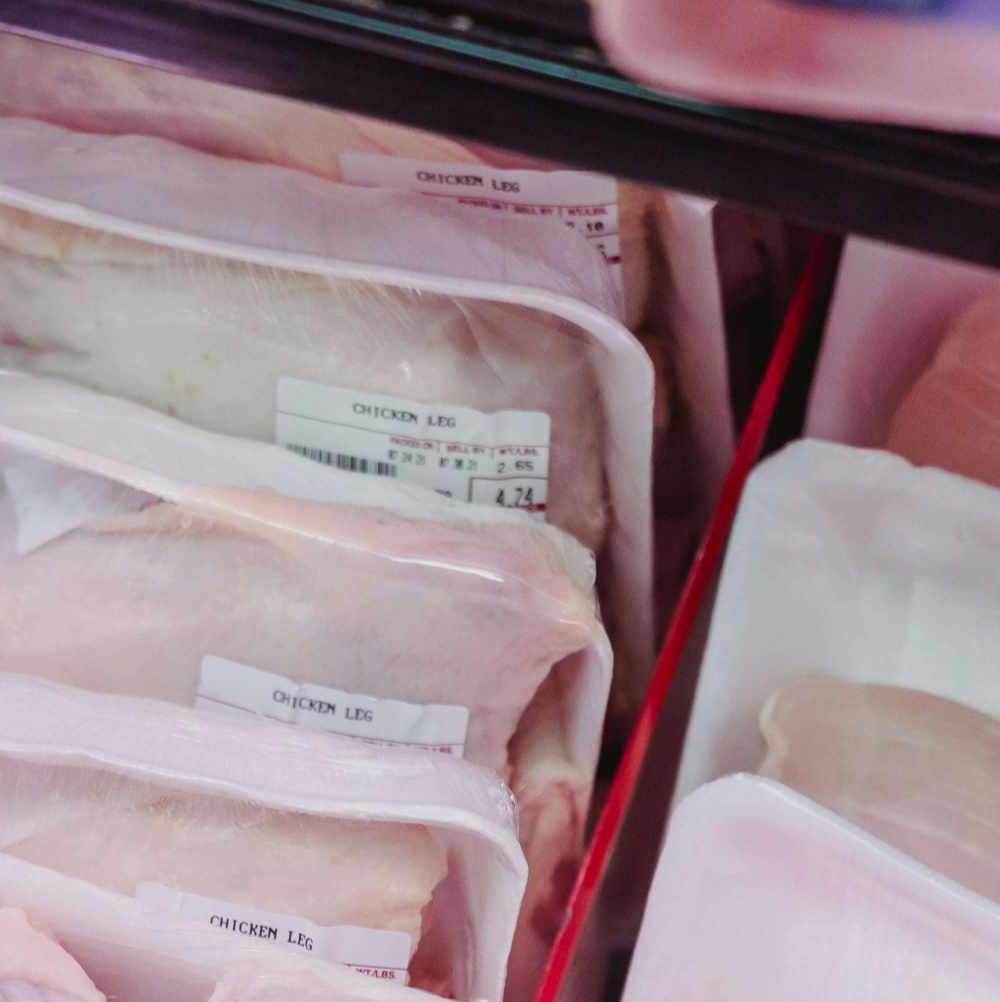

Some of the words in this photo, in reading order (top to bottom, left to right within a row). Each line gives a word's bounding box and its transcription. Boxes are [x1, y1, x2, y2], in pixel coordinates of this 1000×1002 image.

[416, 171, 483, 187] CHICKEN
[492, 179, 520, 193] LEG
[352, 402, 419, 425] CHICKEN
[428, 415, 457, 428] LEG
[272, 690, 336, 716] CHICKEN
[345, 707, 374, 722] LEG
[210, 914, 278, 940] CHICKEN
[287, 930, 314, 951] LEG
